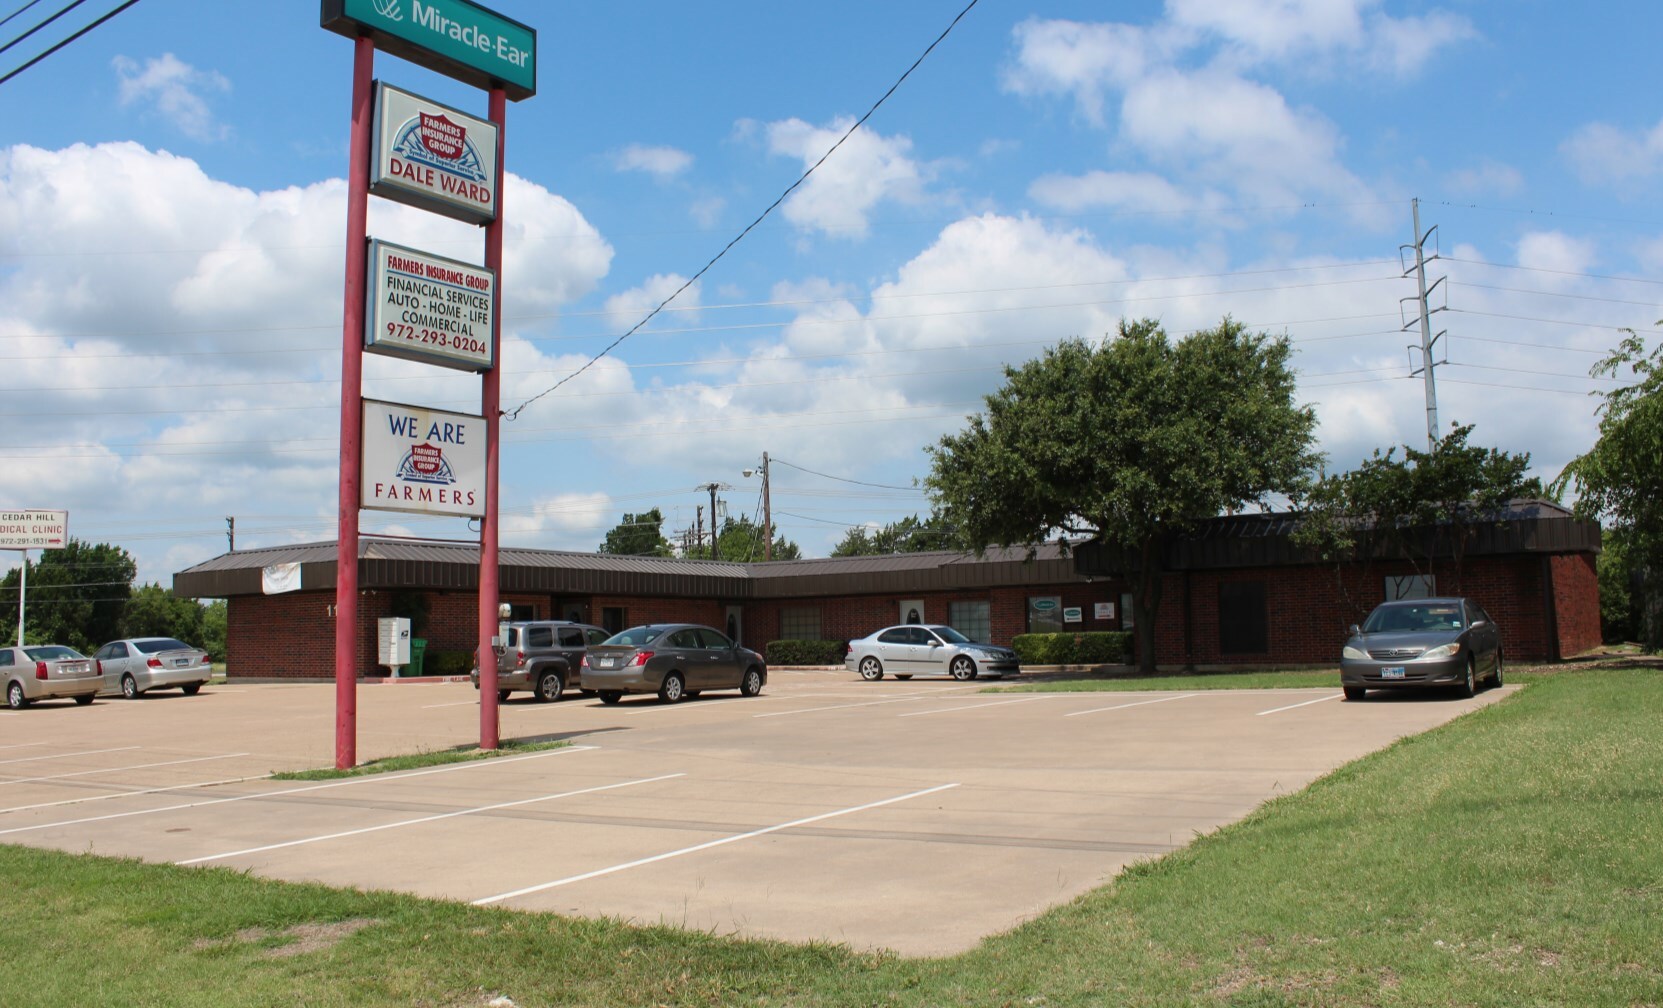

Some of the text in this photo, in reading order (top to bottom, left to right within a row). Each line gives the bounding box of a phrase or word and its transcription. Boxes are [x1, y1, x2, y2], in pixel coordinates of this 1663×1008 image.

[422, 127, 463, 148] INSURANCE
[424, 117, 461, 137] FARMERS
[428, 140, 456, 155] GROUP
[390, 158, 491, 204] DALE WARD
[388, 255, 489, 291] FARMERS INSURANCE GROUP
[387, 276, 489, 311] FINANCIAL SERVICES
[387, 292, 420, 309] AUTO
[429, 301, 461, 319] HOME
[469, 310, 488, 325] LIFE
[402, 310, 474, 337] COMMERCIAL
[387, 322, 486, 354] 972-293-0204
[388, 414, 465, 445] WE ARE
[413, 455, 440, 463] INSURANCE
[414, 447, 438, 456] FARMERS
[417, 462, 435, 470] GROUP
[375, 483, 475, 506] FARMERS
[2, 513, 55, 521] CEDAR HILL
[32, 525, 62, 534] CLINIC
